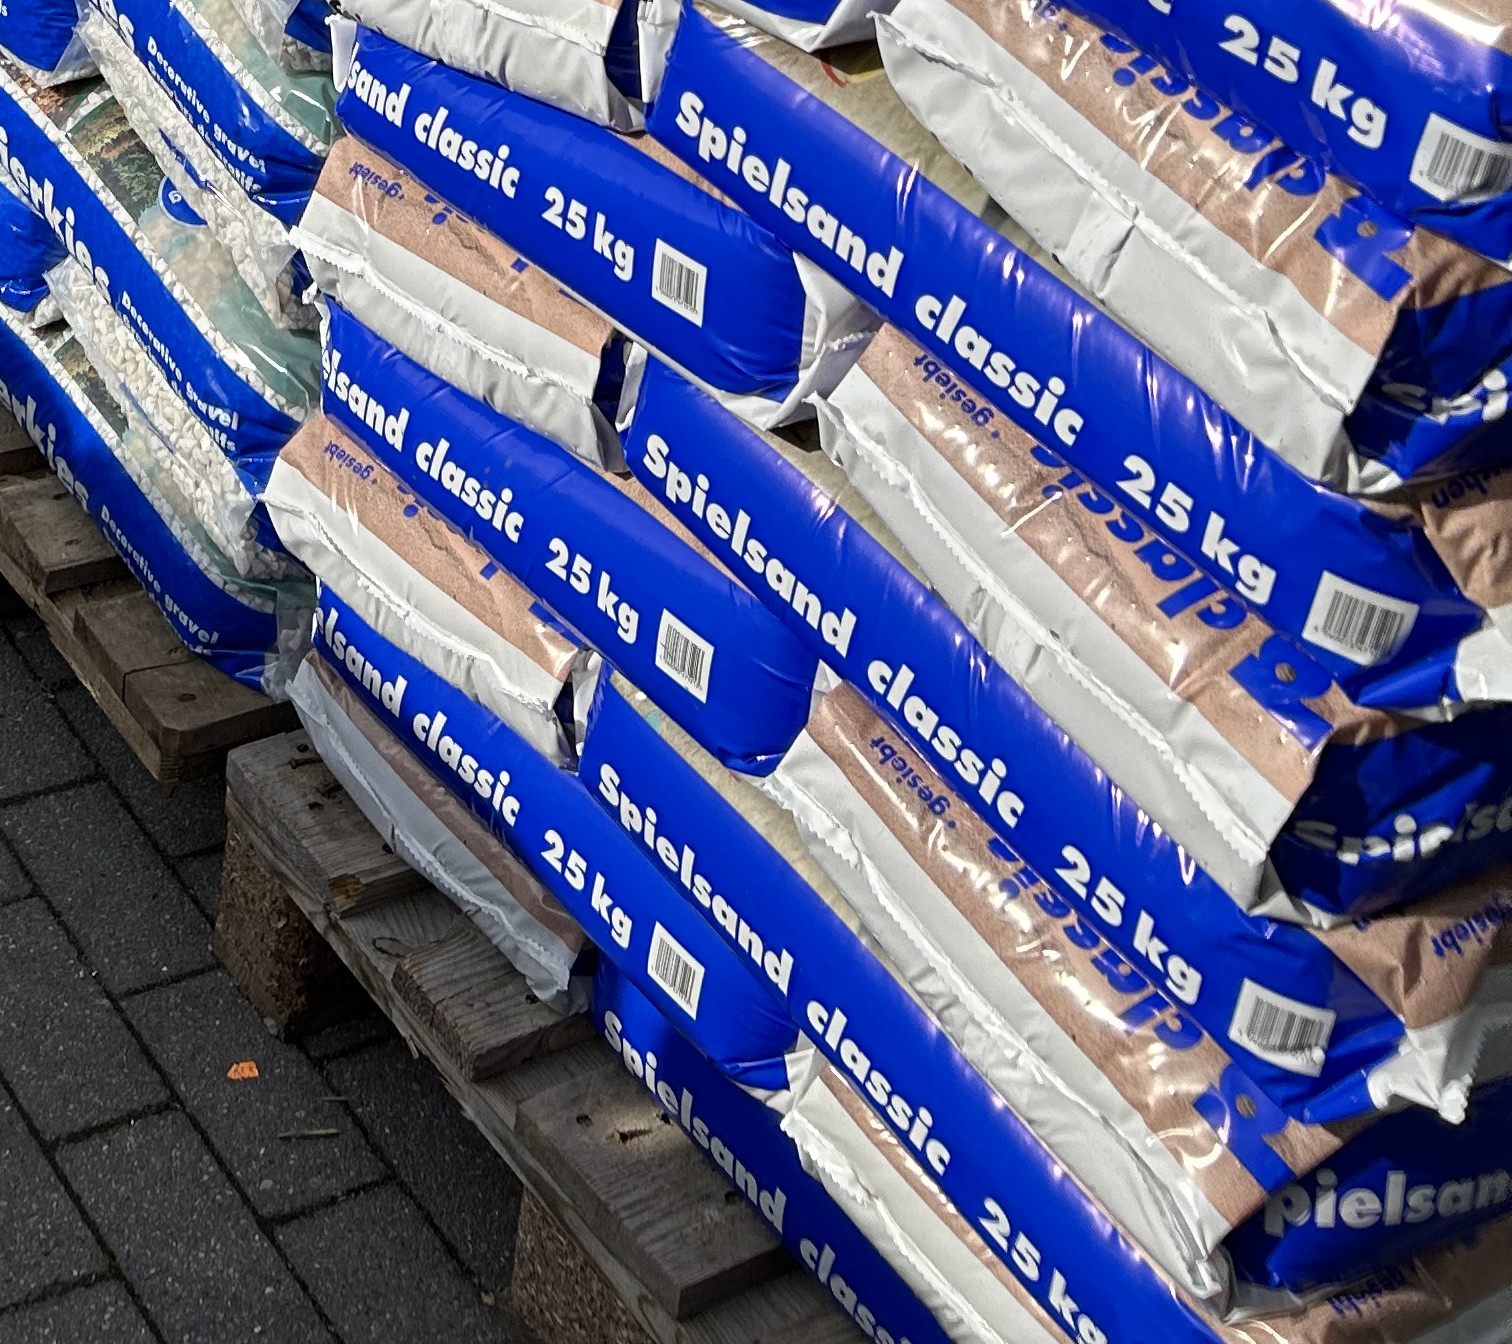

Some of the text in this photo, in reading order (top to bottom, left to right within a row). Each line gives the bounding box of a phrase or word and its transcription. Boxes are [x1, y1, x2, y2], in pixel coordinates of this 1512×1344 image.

[146, 34, 211, 125] Decorative
[213, 121, 268, 176] gravel
[1218, 13, 1300, 85] 25
[1308, 63, 1388, 149] kg
[413, 105, 635, 281] classic 25 kg
[120, 290, 183, 383] Decorative
[185, 380, 240, 435] gravel
[674, 90, 1277, 606] Spielsand classic 25 kg
[909, 352, 998, 434] gesiebt
[100, 502, 164, 603] Decorative
[163, 590, 220, 647] gravel
[415, 438, 640, 646] classic 25 kg
[642, 433, 1205, 1008] Spielsand classic 25 kg
[868, 736, 955, 827] gesiebt
[412, 710, 635, 952] classic 25 kg
[596, 763, 1110, 1344] Spielsand classic 25 kg
[603, 1008, 789, 1236] Spielsand
